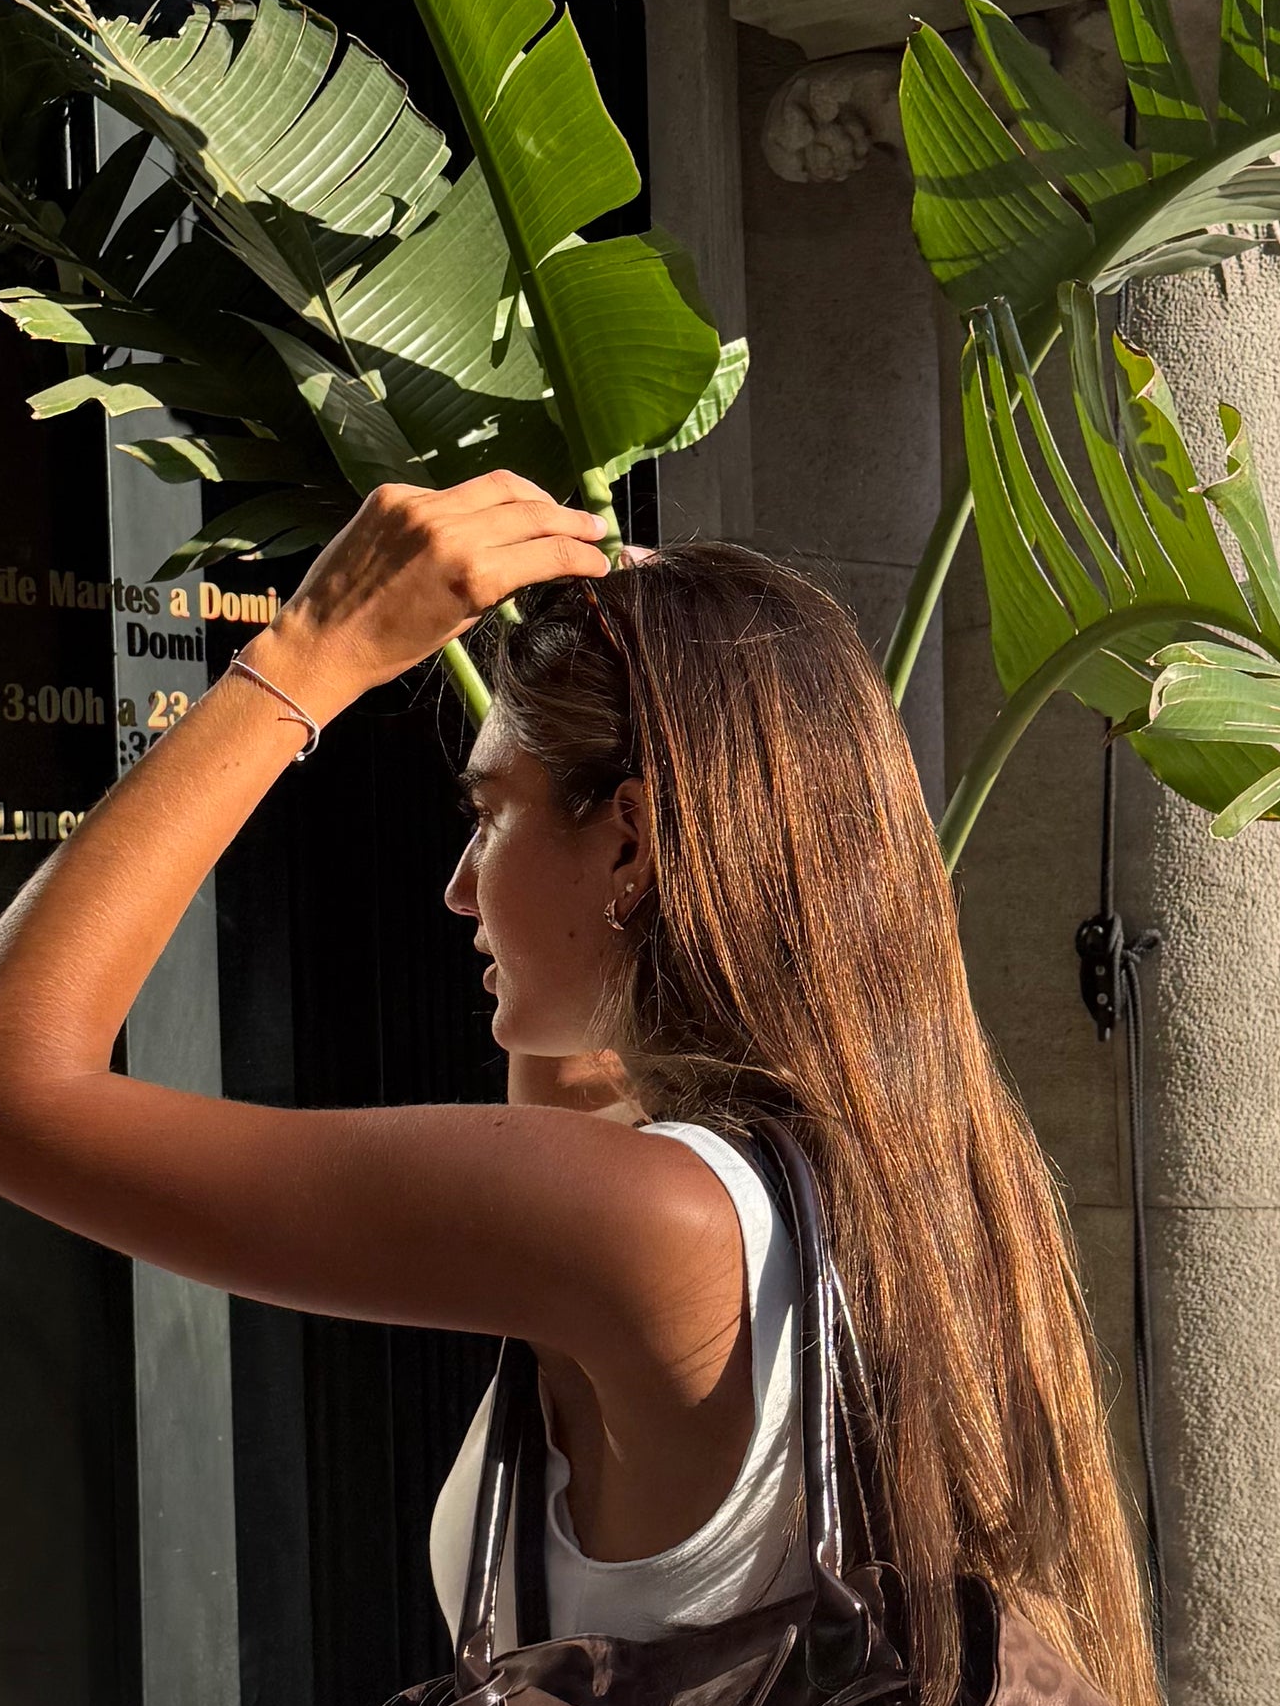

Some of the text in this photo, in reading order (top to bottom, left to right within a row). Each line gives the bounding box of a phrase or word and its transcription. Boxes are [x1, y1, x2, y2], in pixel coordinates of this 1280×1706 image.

[49, 569, 160, 616] Martes
[169, 586, 190, 620] a
[198, 581, 281, 625] Domi
[118, 697, 138, 728] a
